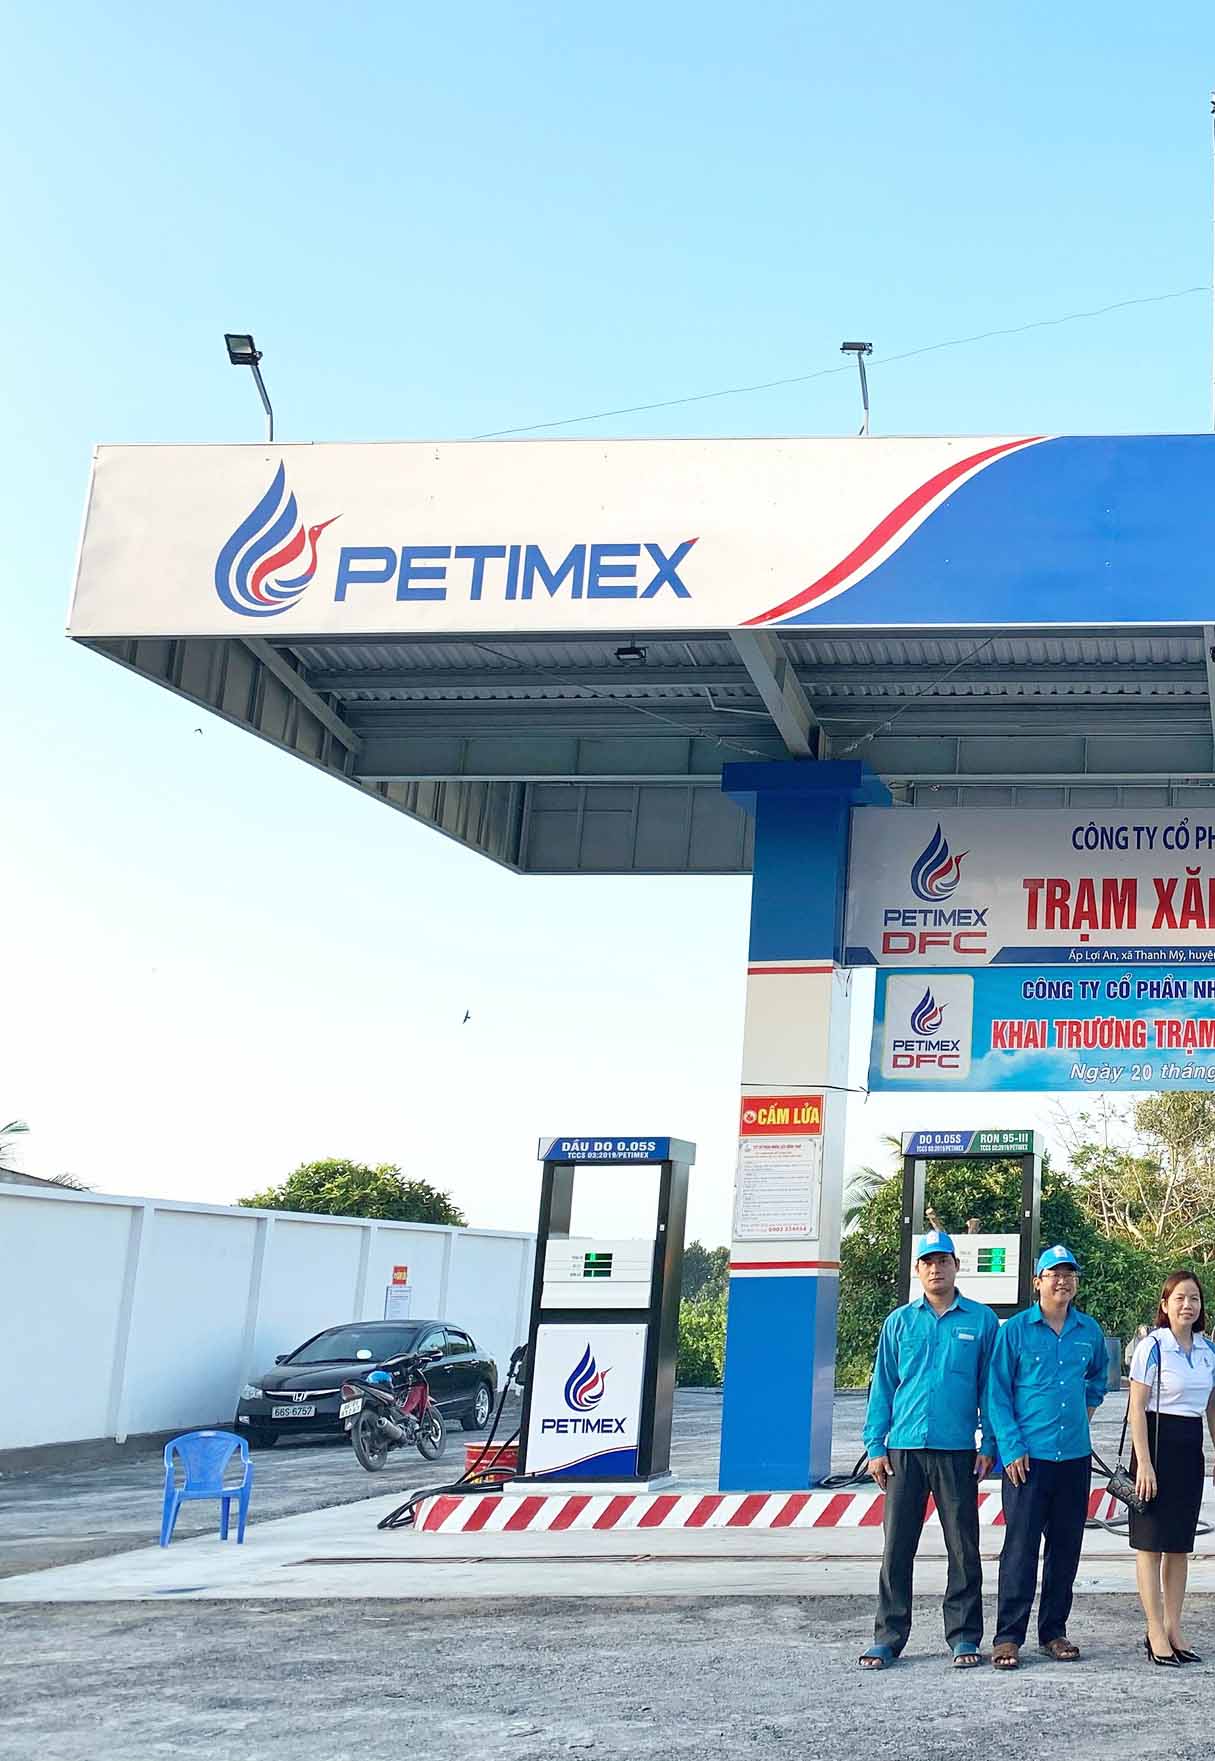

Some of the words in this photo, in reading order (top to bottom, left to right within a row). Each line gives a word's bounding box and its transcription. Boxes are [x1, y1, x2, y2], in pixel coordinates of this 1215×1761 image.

[333, 536, 700, 602] PETIMEX
[1071, 820, 1130, 850] CÔNG
[1132, 826, 1158, 850] TY
[1163, 817, 1190, 850] CỔ
[883, 906, 990, 928] PETIMEX
[1022, 877, 1137, 942] TRẠM
[882, 931, 988, 955] DFC
[1085, 950, 1101, 962] Lợi
[1102, 950, 1119, 961] An,
[1121, 950, 1133, 961] xã
[1134, 949, 1167, 960] Thanh
[1169, 949, 1186, 962] Mỹ,
[1022, 976, 1073, 999] CÔNG
[1079, 980, 1100, 999] TY
[1106, 973, 1132, 999] CỔ
[1136, 974, 1188, 999] PHẦN
[991, 1019, 1047, 1050] KHAI
[1054, 1015, 1147, 1050] TRƯƠNG
[892, 1039, 961, 1052] PETIMEX
[892, 1054, 960, 1069] DFC
[1070, 1062, 1123, 1082] Ngày
[1130, 1064, 1152, 1082] 20
[757, 1102, 790, 1125] CẤM
[793, 1102, 820, 1125] LỬA
[593, 1141, 613, 1152] DO
[616, 1141, 657, 1152] 0.05S
[920, 1134, 932, 1144] DO
[935, 1134, 961, 1144] 0.05S
[980, 1133, 1000, 1144] RON
[1003, 1133, 1028, 1143] 95-III
[568, 1151, 586, 1159] TCCS
[541, 1416, 628, 1434] PETIMEX
